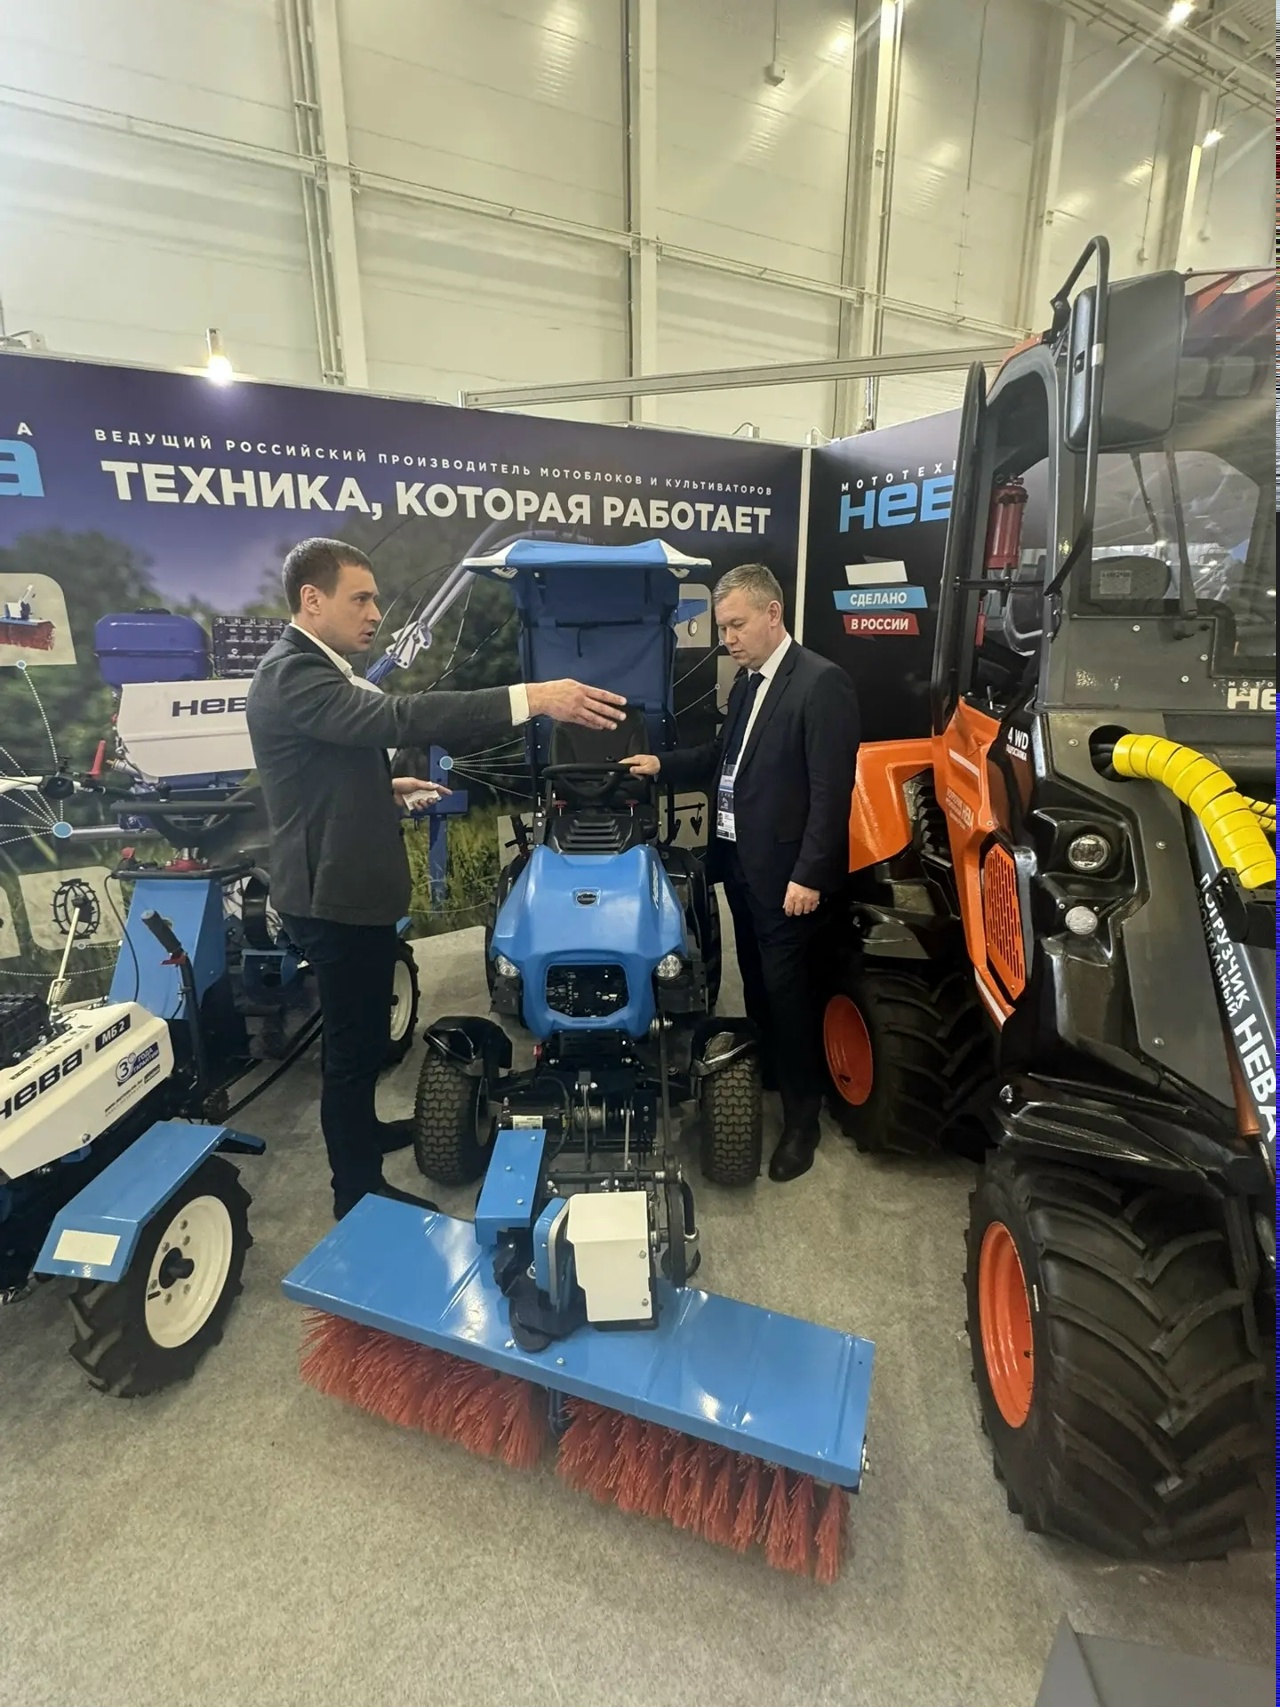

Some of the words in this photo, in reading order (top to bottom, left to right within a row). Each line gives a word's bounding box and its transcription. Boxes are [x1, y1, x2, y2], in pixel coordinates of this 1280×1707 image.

[94, 429, 212, 450] ВЕДУЩИЙ
[225, 439, 367, 462] РОССИЙСКИЙ
[378, 453, 531, 476] ПРОИЗВОДИТЕЛЬ
[540, 467, 642, 485] МОТОБЛОКОВ
[650, 477, 657, 486] И
[665, 478, 772, 496] КУЛЬТИВАТОРОВ
[101, 460, 383, 520] ТЕХНИКА,
[395, 481, 591, 525] КОТОРАЯ
[603, 495, 771, 535] РАБОТАЕТ
[850, 591, 907, 607] СДЕЛАНО
[851, 618, 859, 630] В
[861, 618, 909, 631] РОССИИ
[1007, 726, 1013, 744] 4
[1014, 729, 1029, 750] WD
[101, 1027, 118, 1045] МБ
[119, 1021, 125, 1032] 2
[118, 1061, 129, 1078] 3
